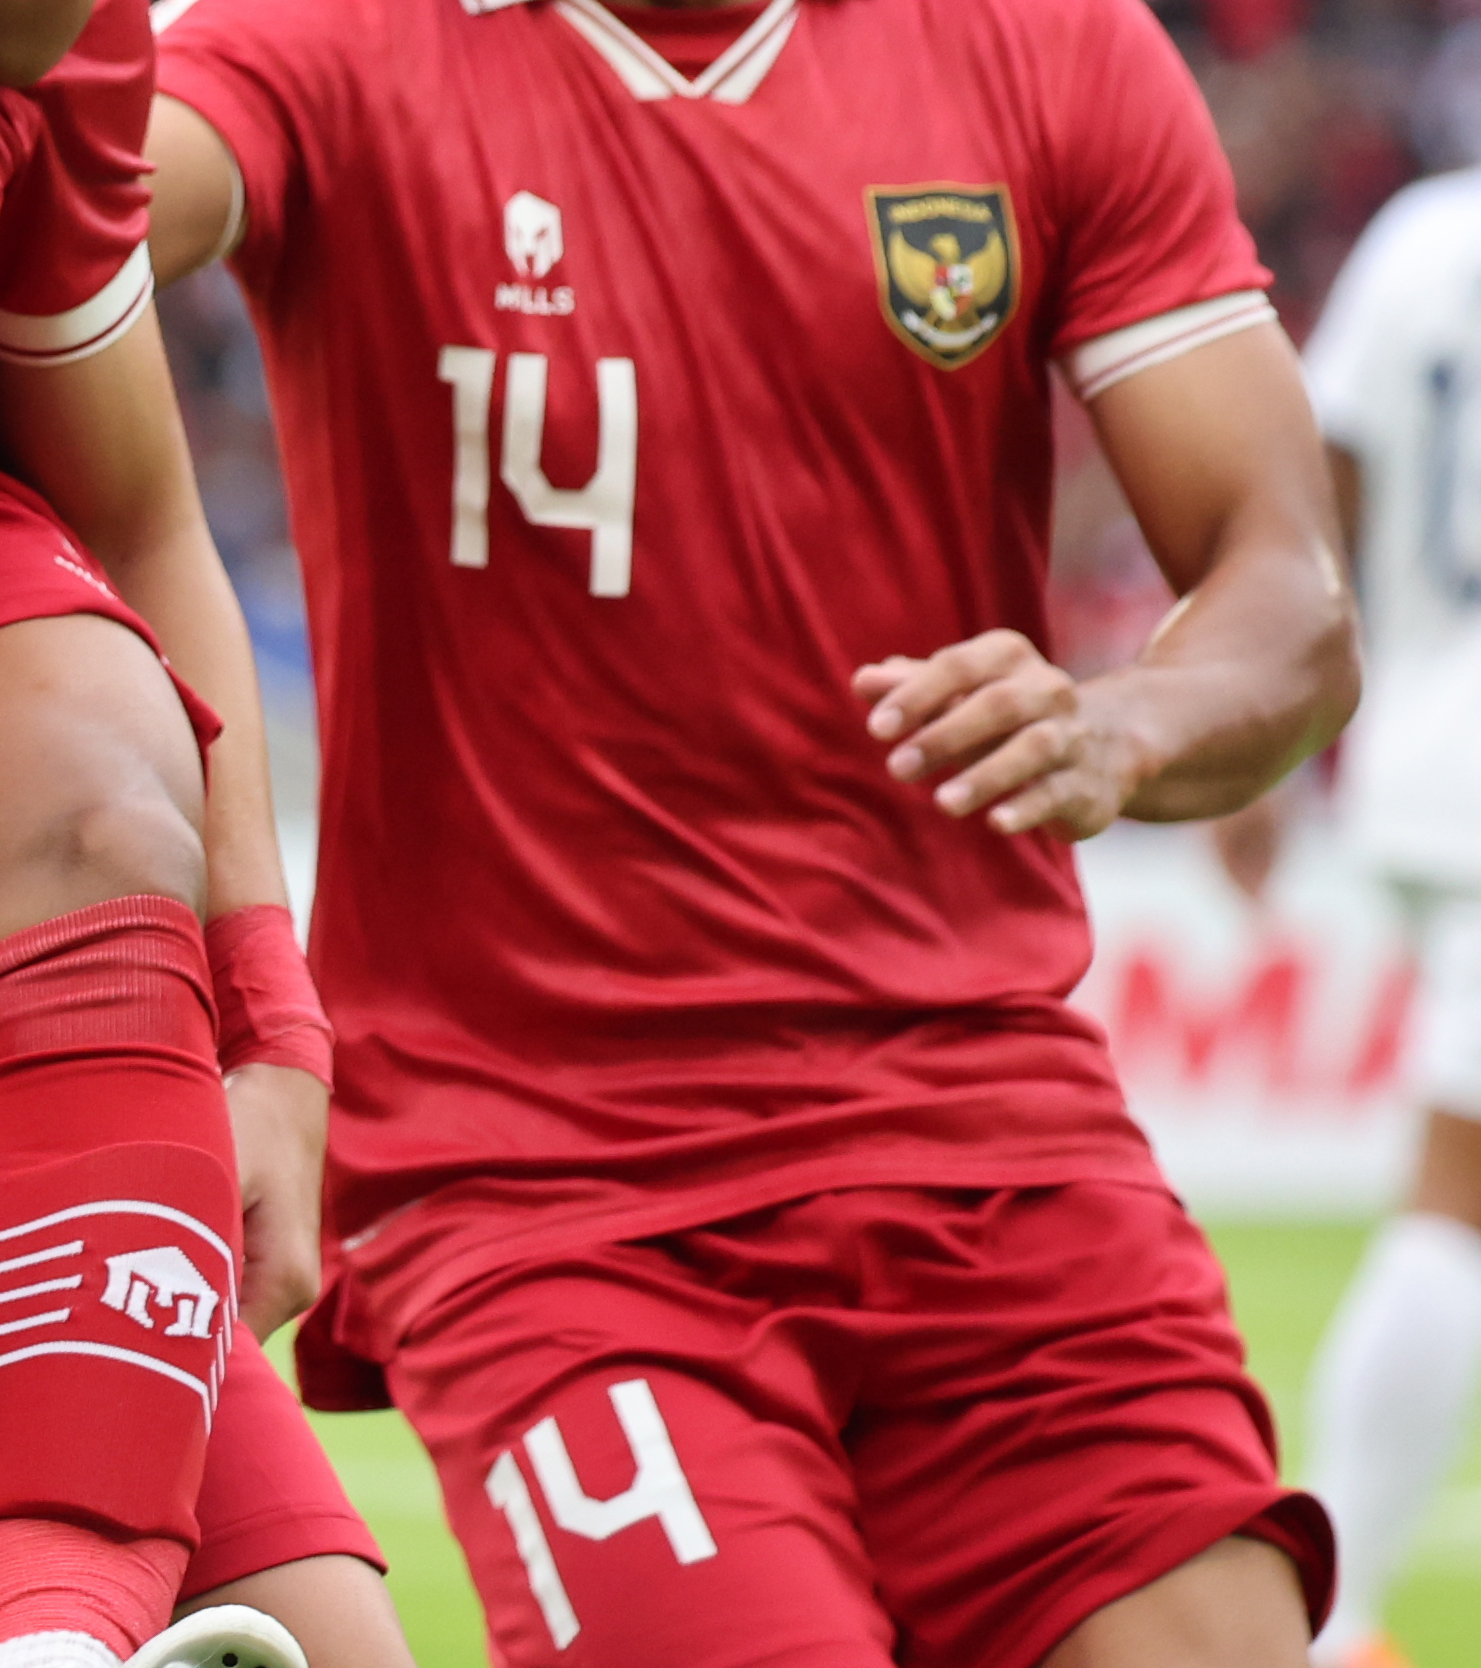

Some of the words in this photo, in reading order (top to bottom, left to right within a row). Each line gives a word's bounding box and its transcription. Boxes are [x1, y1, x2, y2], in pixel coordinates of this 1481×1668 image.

[494, 282, 576, 316] MILLS
[439, 346, 637, 598] 14
[484, 1378, 719, 1651] 14
